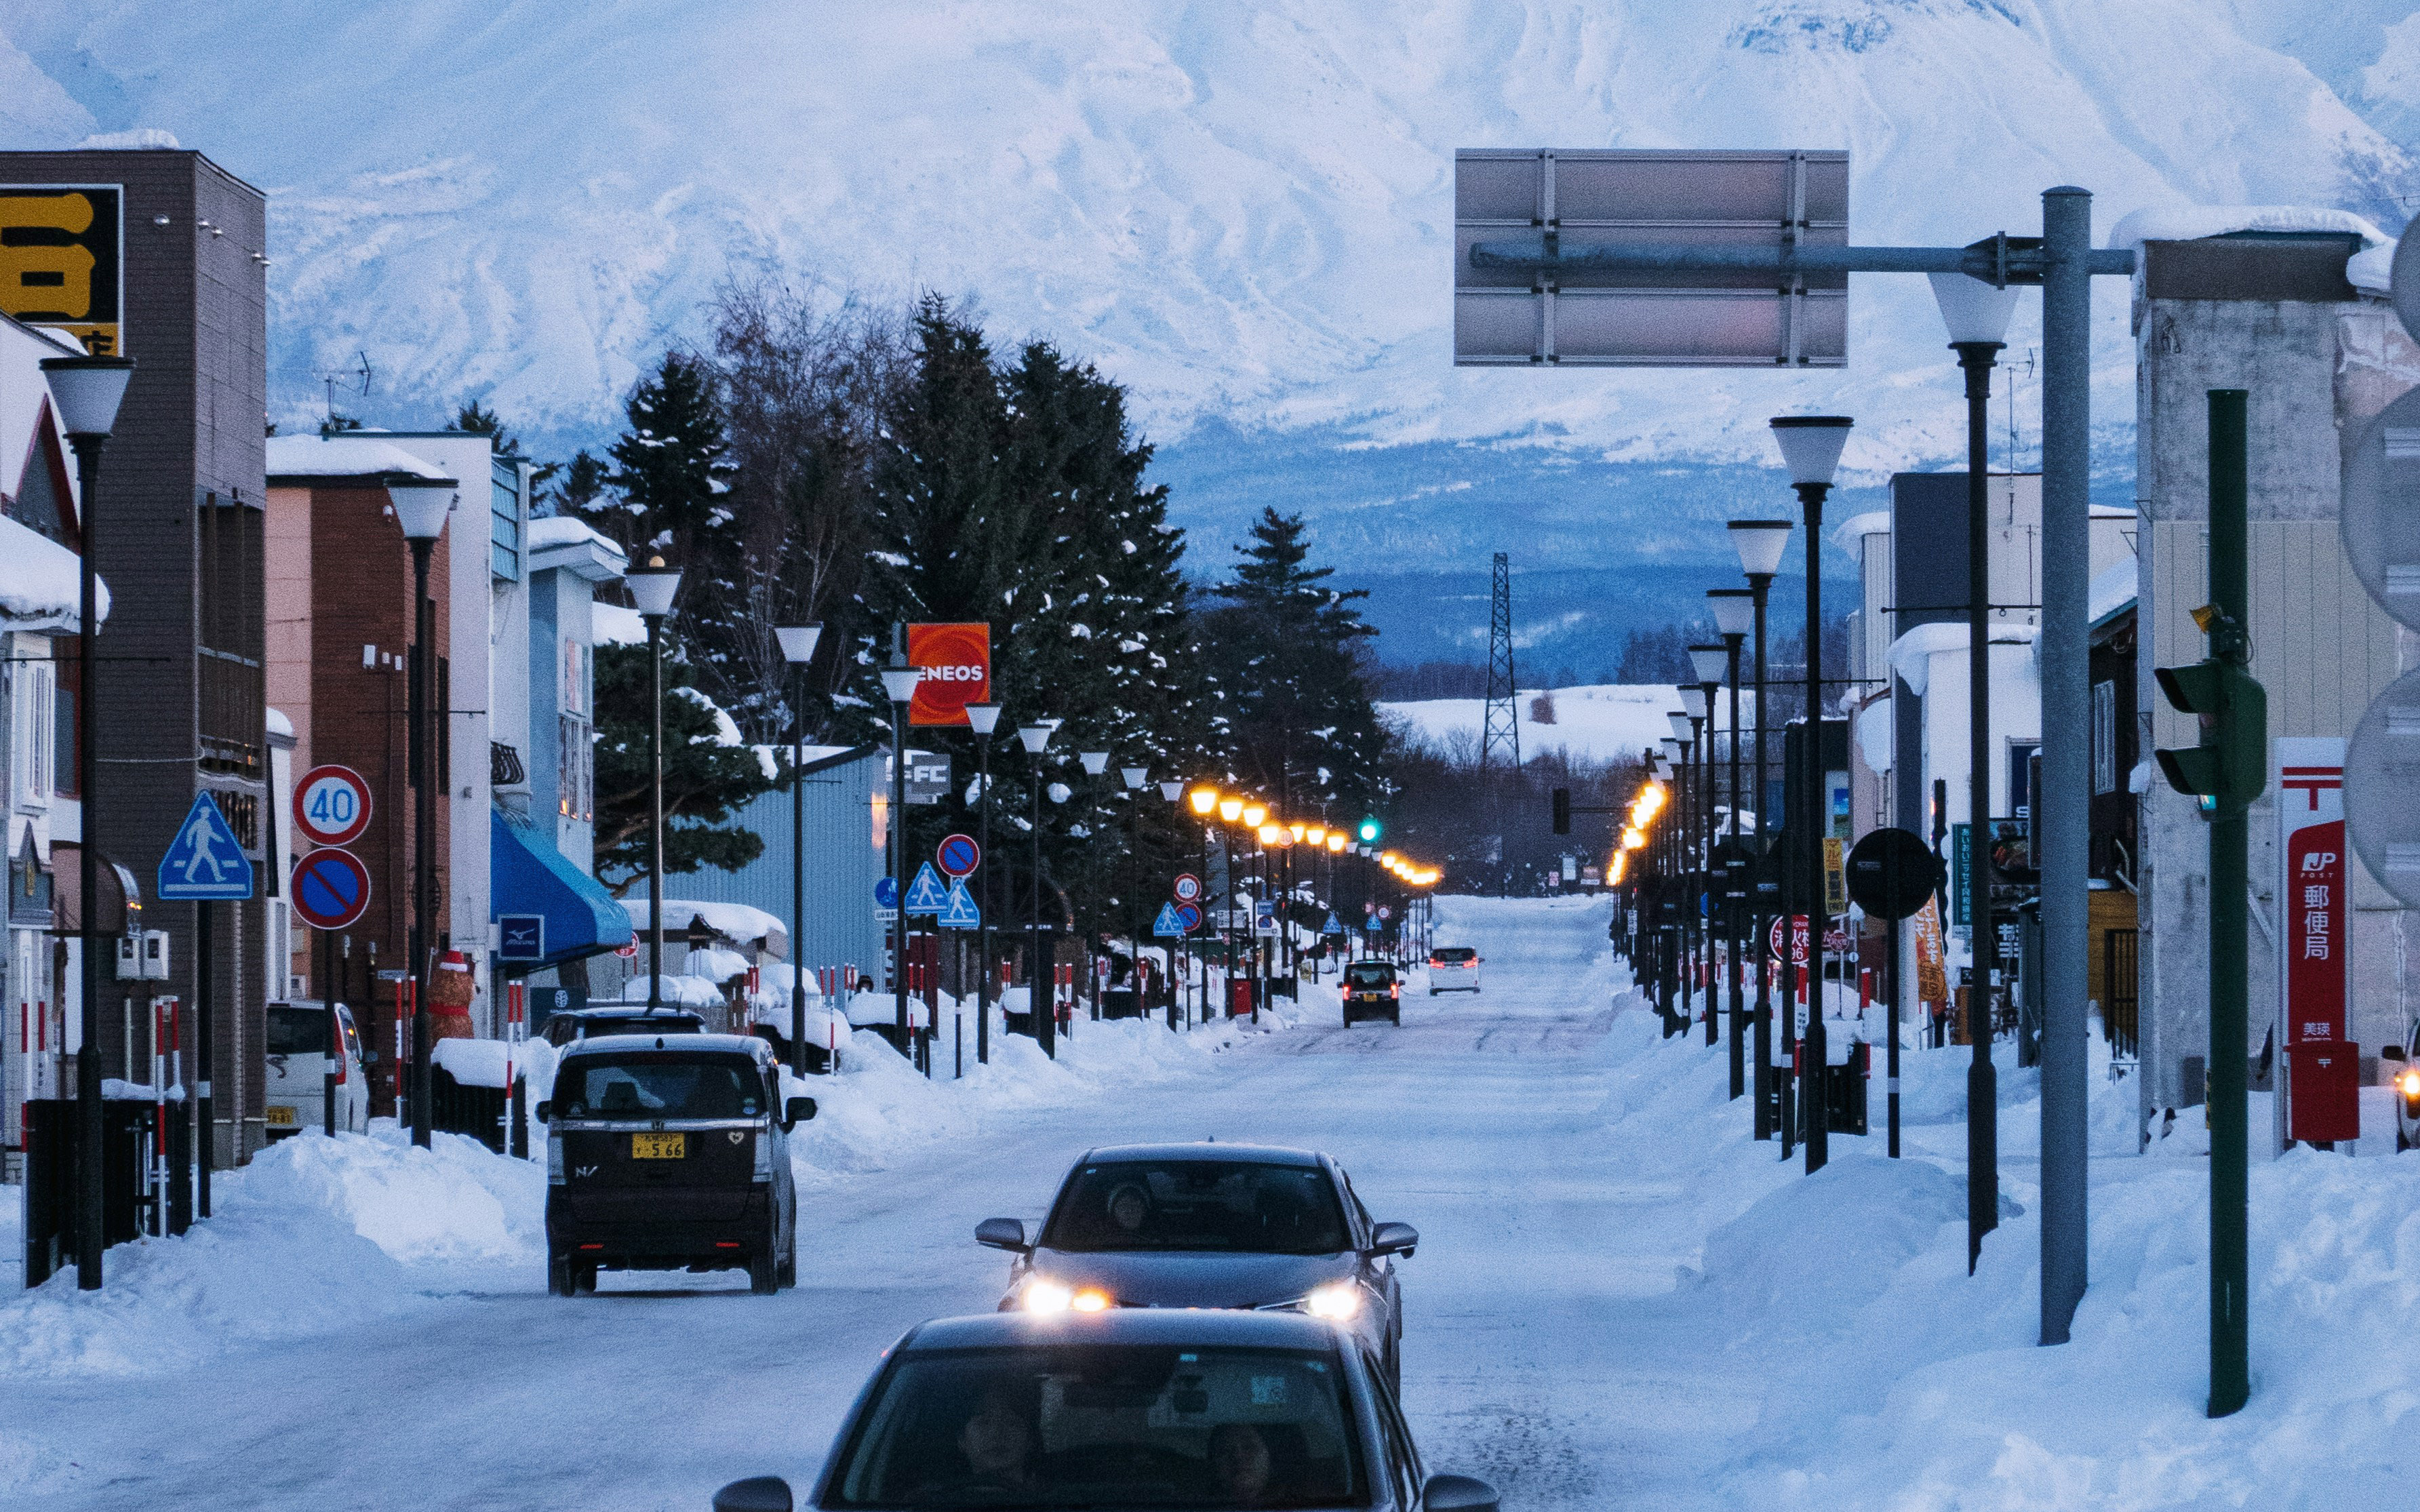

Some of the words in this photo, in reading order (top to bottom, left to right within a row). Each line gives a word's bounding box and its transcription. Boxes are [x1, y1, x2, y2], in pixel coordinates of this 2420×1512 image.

[311, 788, 353, 822] 40
[1178, 882, 1195, 894] 40
[2304, 885, 2330, 961] 郵便局
[2303, 1022, 2330, 1036] 美瑛
